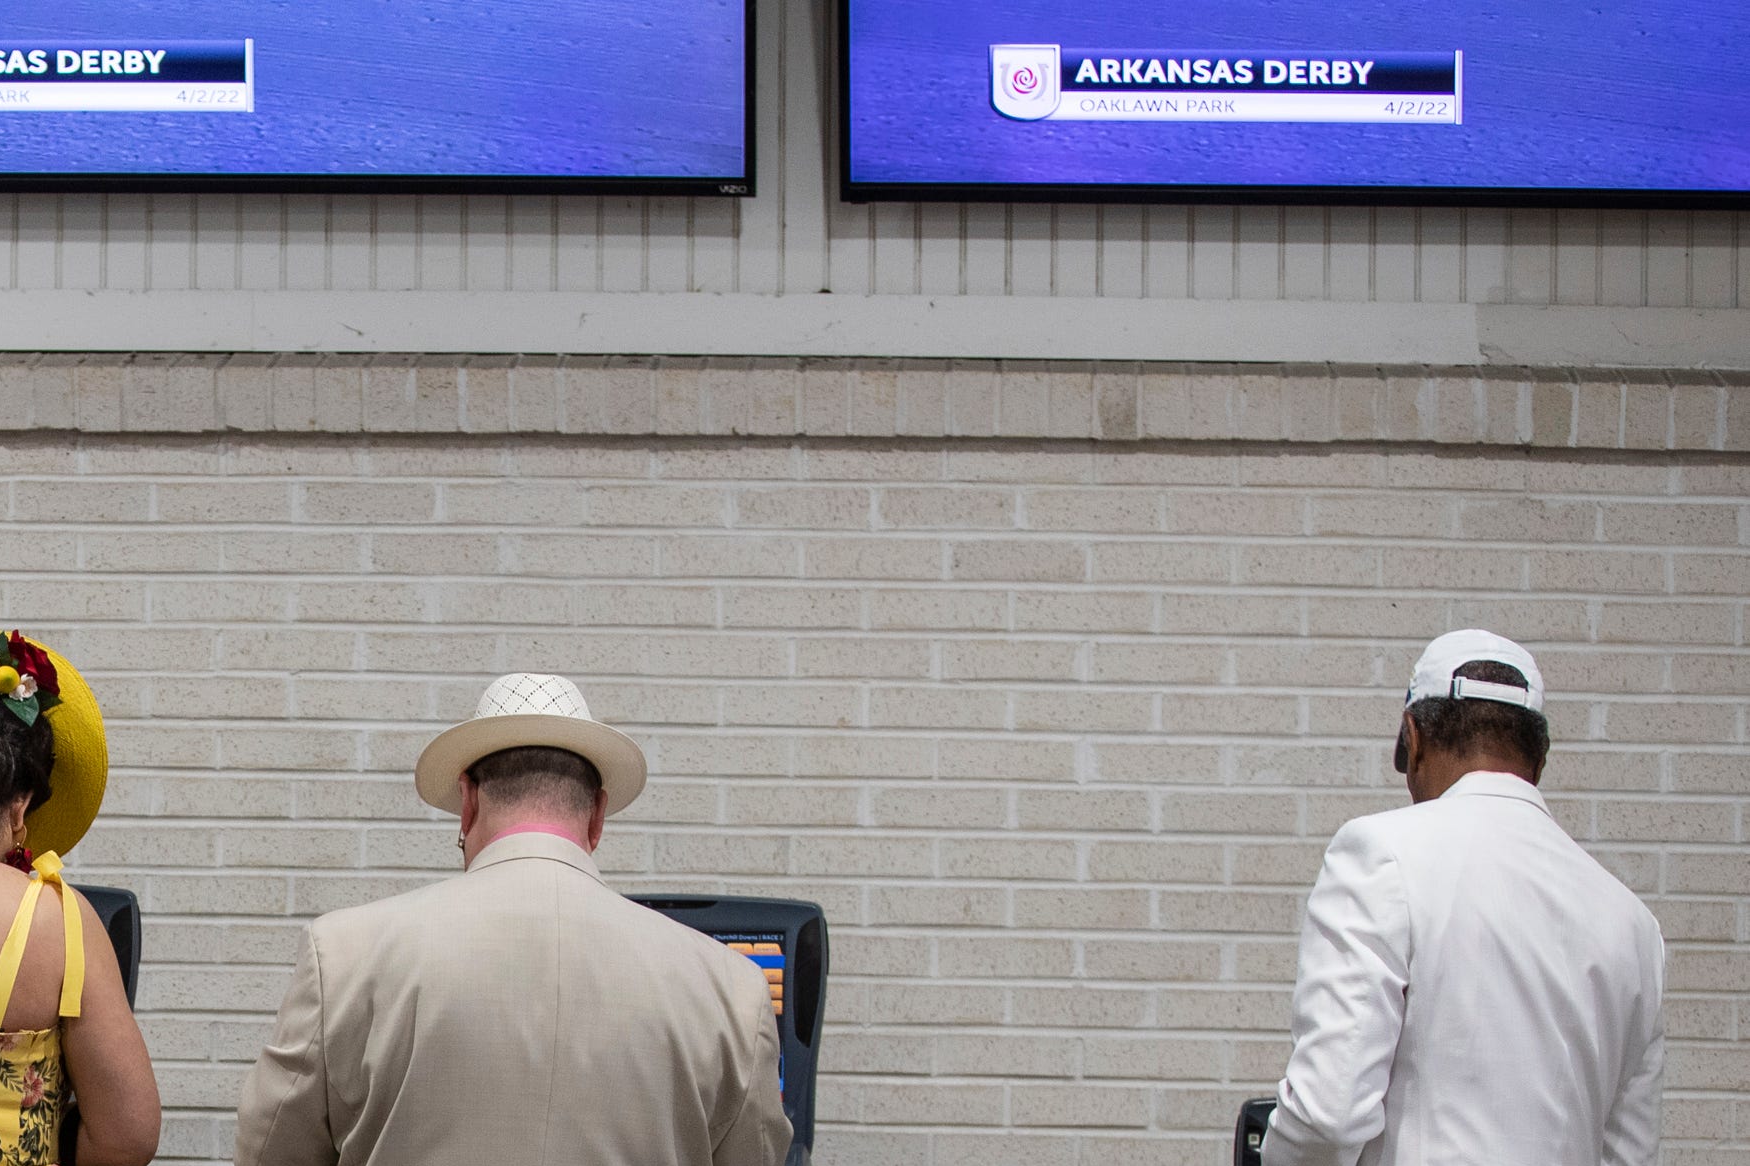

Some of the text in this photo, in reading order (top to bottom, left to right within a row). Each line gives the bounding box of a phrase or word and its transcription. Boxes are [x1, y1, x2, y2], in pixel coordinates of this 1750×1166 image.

[56, 49, 166, 74] DERBY
[1074, 58, 1374, 85] ARKANSAS DERBY
[177, 90, 240, 103] 4/2/22
[1080, 99, 1235, 113] OAKLAWN PARK
[1384, 101, 1448, 115] 4/2/22
